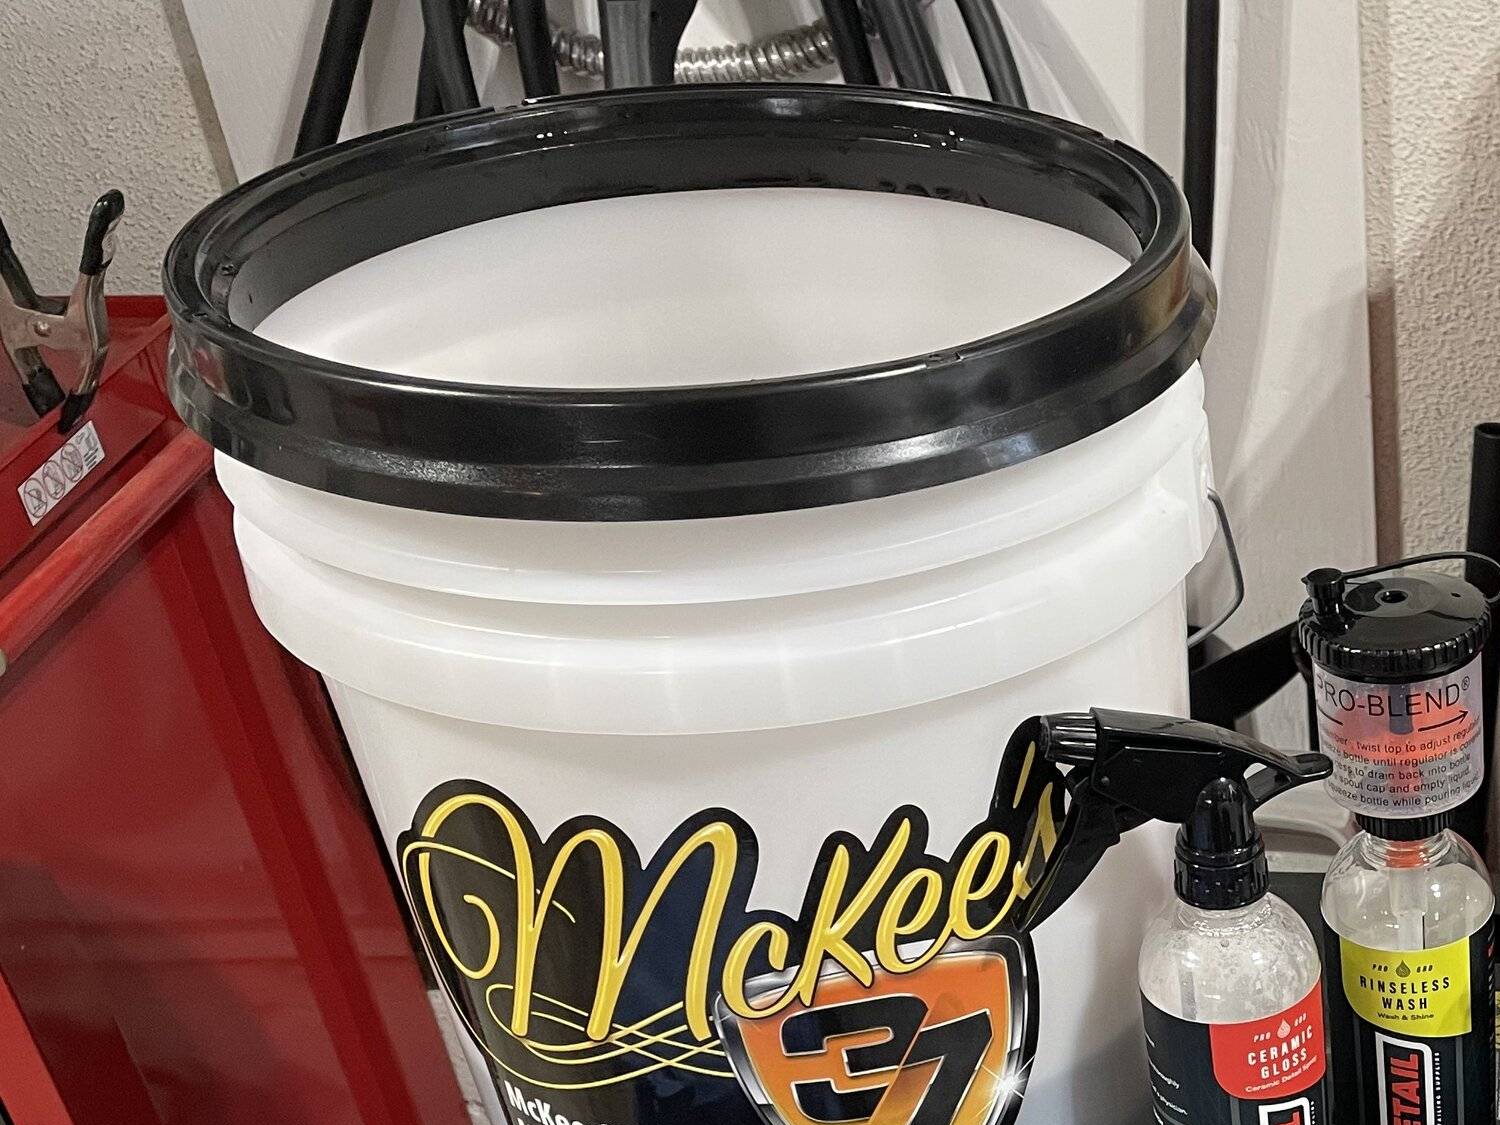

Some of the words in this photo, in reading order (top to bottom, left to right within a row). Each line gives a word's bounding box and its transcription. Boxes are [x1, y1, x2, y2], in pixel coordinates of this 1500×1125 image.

[1357, 743, 1381, 752] twist
[1384, 744, 1402, 754] top
[1405, 742, 1416, 752] to
[1420, 736, 1451, 751] adjust
[1343, 750, 1370, 765] bottle
[1373, 758, 1397, 767] until
[1400, 753, 1448, 768] regulator
[1355, 768, 1364, 777] to
[1367, 768, 1395, 780] drain
[1399, 769, 1425, 780] back
[1428, 764, 1447, 777] into
[1366, 784, 1385, 794] cap
[1389, 784, 1410, 793] and
[1413, 778, 1446, 792] empty
[1360, 794, 1389, 806] bottle
[1393, 797, 1421, 807] while
[1425, 785, 1460, 805] pouring
[1360, 975, 1450, 994] RINSELESS
[1382, 996, 1427, 1010] WASH
[1377, 1012, 1400, 1020] Wash
[1248, 1025, 1312, 1065] CERAMIC
[1261, 1048, 1307, 1079] GLOSS
